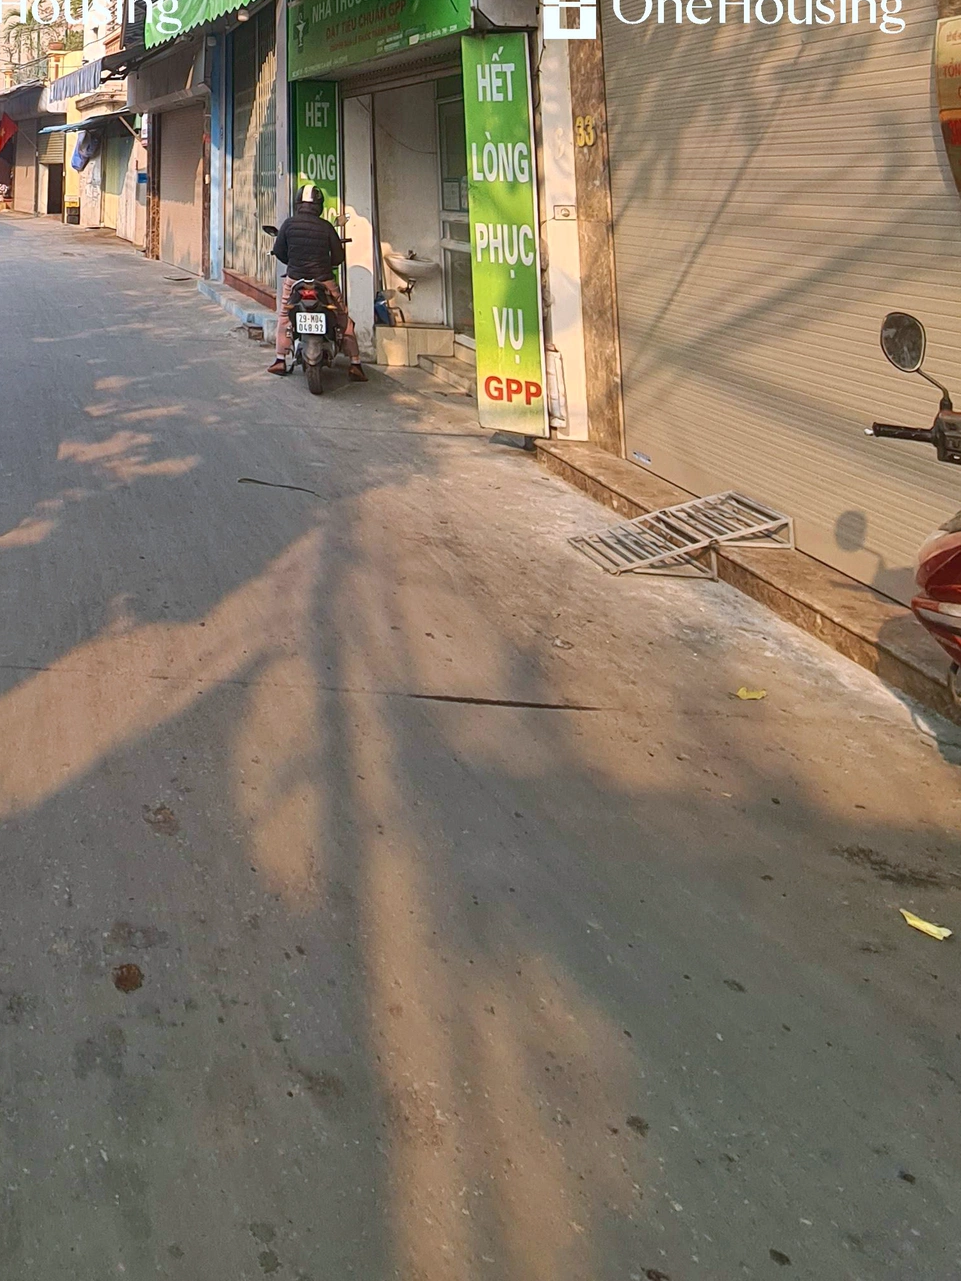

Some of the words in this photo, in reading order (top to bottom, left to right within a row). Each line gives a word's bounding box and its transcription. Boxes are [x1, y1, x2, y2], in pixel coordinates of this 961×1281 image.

[312, 2, 332, 24] NHÀ
[477, 47, 515, 103] HẾT
[305, 91, 330, 128] HẾT
[576, 115, 594, 147] 33
[300, 147, 336, 181] LÒNG
[472, 131, 529, 184] LÒNG
[475, 222, 534, 279] PHỤC
[492, 306, 525, 364] VỤ
[484, 376, 543, 406] GPP
